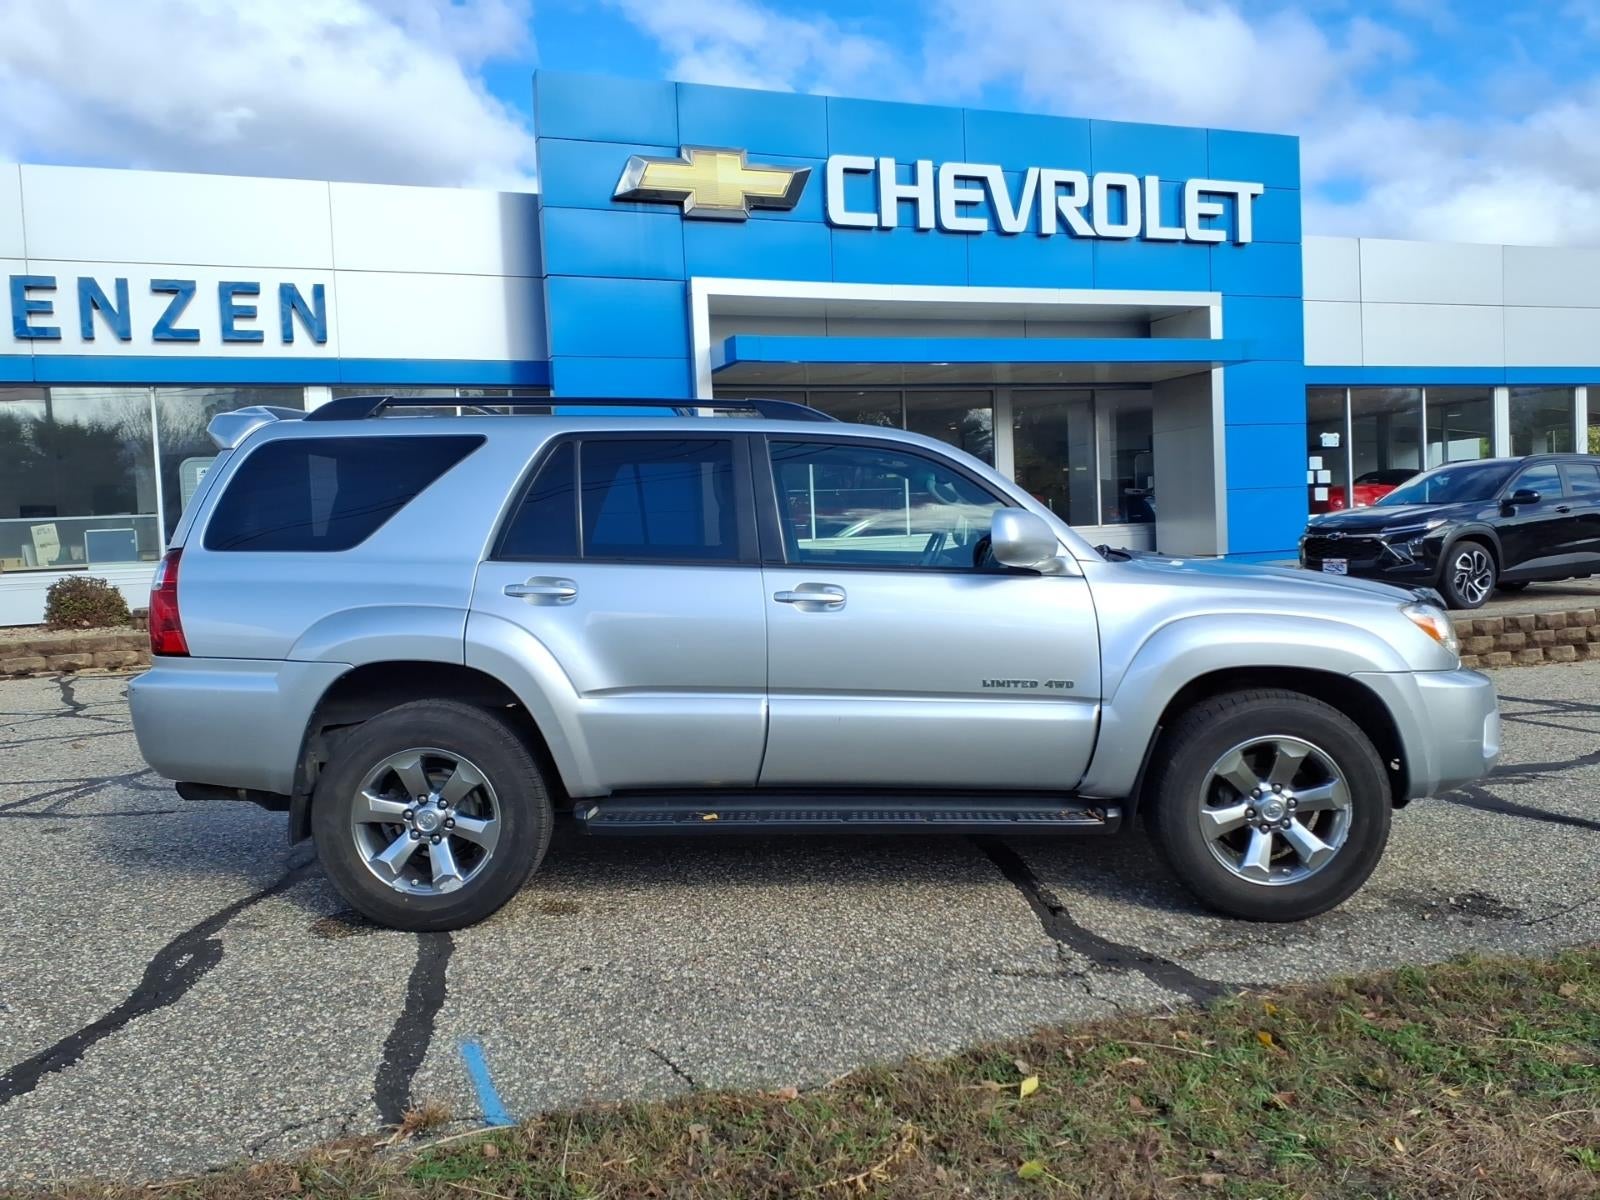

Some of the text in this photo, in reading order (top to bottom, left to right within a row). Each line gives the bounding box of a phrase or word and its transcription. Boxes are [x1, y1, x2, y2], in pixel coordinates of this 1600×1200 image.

[827, 154, 1264, 244] CHEVROLET
[9, 275, 327, 344] ENZEN
[982, 679, 1075, 689] LIMITED 4WD
